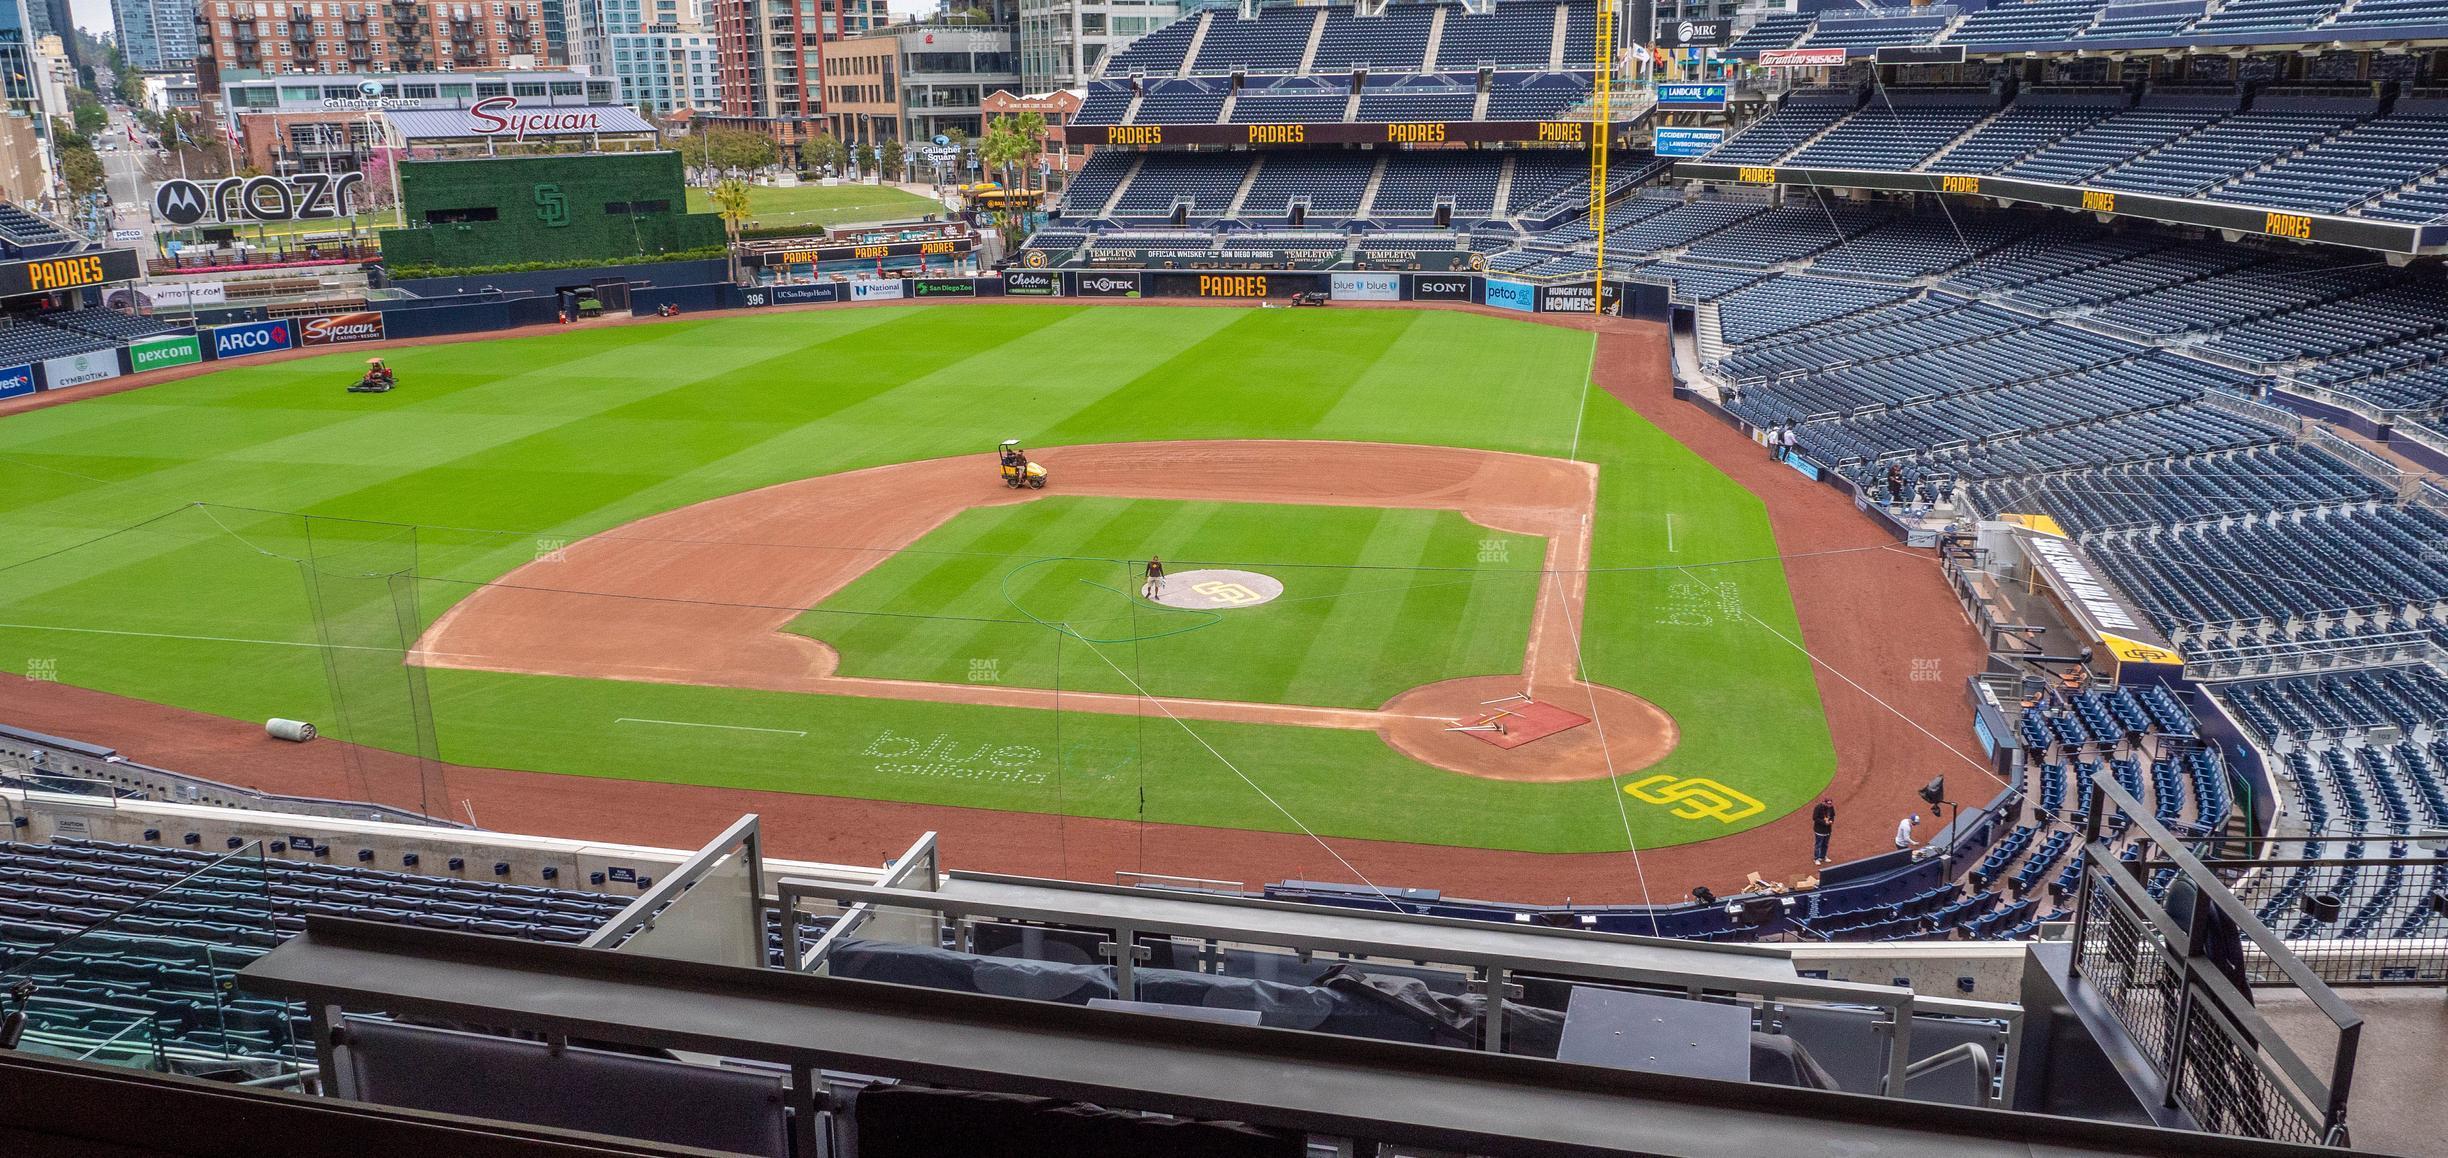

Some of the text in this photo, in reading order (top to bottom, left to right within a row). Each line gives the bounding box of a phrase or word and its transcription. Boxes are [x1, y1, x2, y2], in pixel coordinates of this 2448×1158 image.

[1693, 25, 1716, 35] MRC
[1761, 52, 1842, 65] Tarantino SAUSAGES
[1669, 87, 1724, 97] LANDCARE LOGIC
[323, 97, 420, 110] Gallagher Square
[470, 96, 602, 143] Sycuan
[1108, 126, 1162, 145] PADRES
[1249, 124, 1304, 143] PADRES
[1388, 123, 1445, 142] PADRES
[1539, 122, 1582, 142] PADRES
[922, 145, 961, 156] Gallagher
[928, 153, 956, 162] Square
[1739, 167, 1775, 183] PADRES
[1943, 175, 1978, 193] PADRES
[213, 171, 365, 224] razr
[2082, 190, 2114, 212] PADRES
[2265, 212, 2311, 239] PADRES
[116, 230, 141, 238] petco
[855, 245, 889, 259] PADRES
[921, 241, 954, 254] PADRES
[1089, 249, 1137, 258] TEMPLETON
[783, 250, 818, 263] PADRES
[1285, 250, 1334, 259] TEMPLETON
[1366, 251, 1416, 260] TEMPLETON
[28, 255, 104, 291] PADRES
[1009, 273, 1049, 286] Chosen
[869, 283, 900, 292] National
[943, 284, 959, 293] Diego
[1083, 277, 1133, 292] EVOTEK
[1200, 275, 1267, 297] PADRES
[1334, 280, 1355, 290] blue
[1366, 280, 1388, 290] blue
[1422, 282, 1466, 293] SONY
[798, 290, 814, 298] Diego
[814, 289, 832, 297] Health
[1488, 284, 1517, 300] petco
[1549, 287, 1593, 296] HUNGRY FOR
[747, 294, 764, 306] 396
[1546, 297, 1596, 311] HOMERS
[305, 318, 376, 342] Sycuan
[219, 329, 270, 351] ARCO
[59, 371, 109, 386] CYMBIOTIKA
[861, 729, 1042, 768] blue
[874, 762, 1051, 784] california
